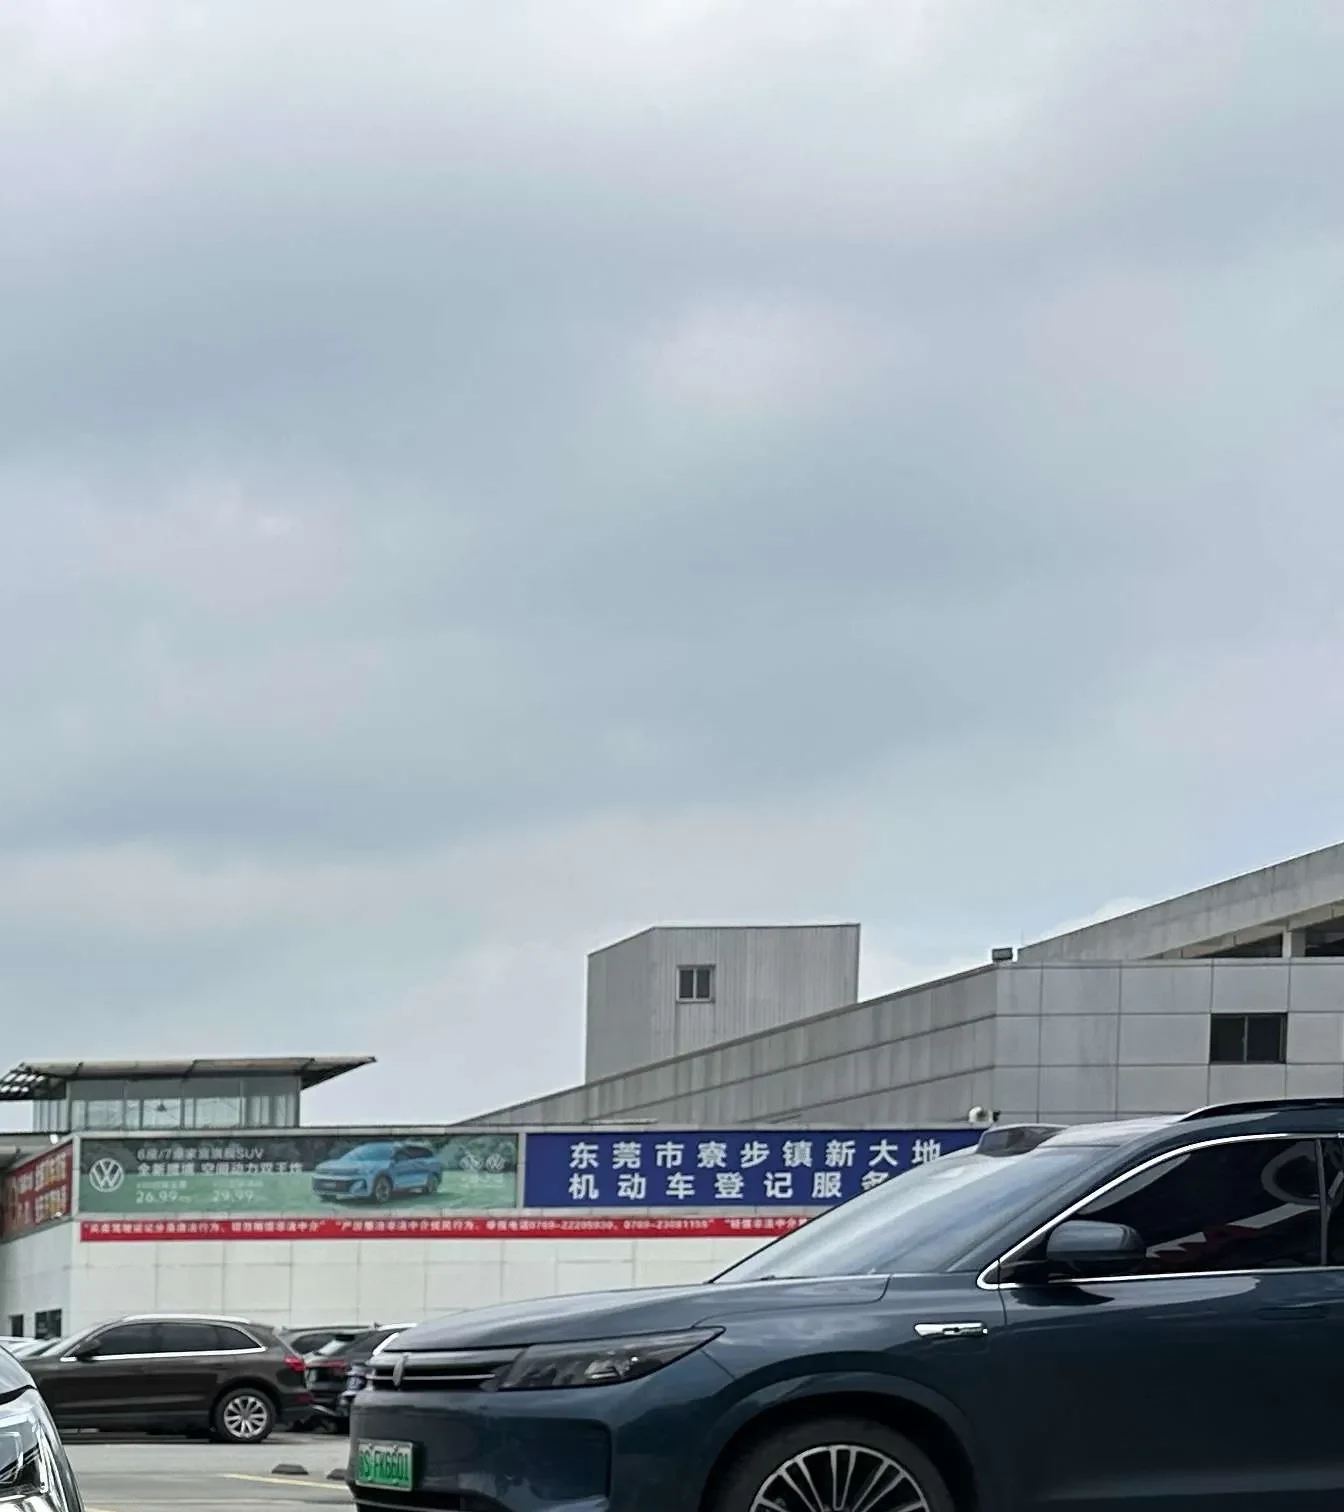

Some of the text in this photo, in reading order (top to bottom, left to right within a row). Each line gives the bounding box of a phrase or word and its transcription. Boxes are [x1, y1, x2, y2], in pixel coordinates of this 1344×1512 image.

[568, 1139, 941, 1168] 东莞市寮步镇新大地
